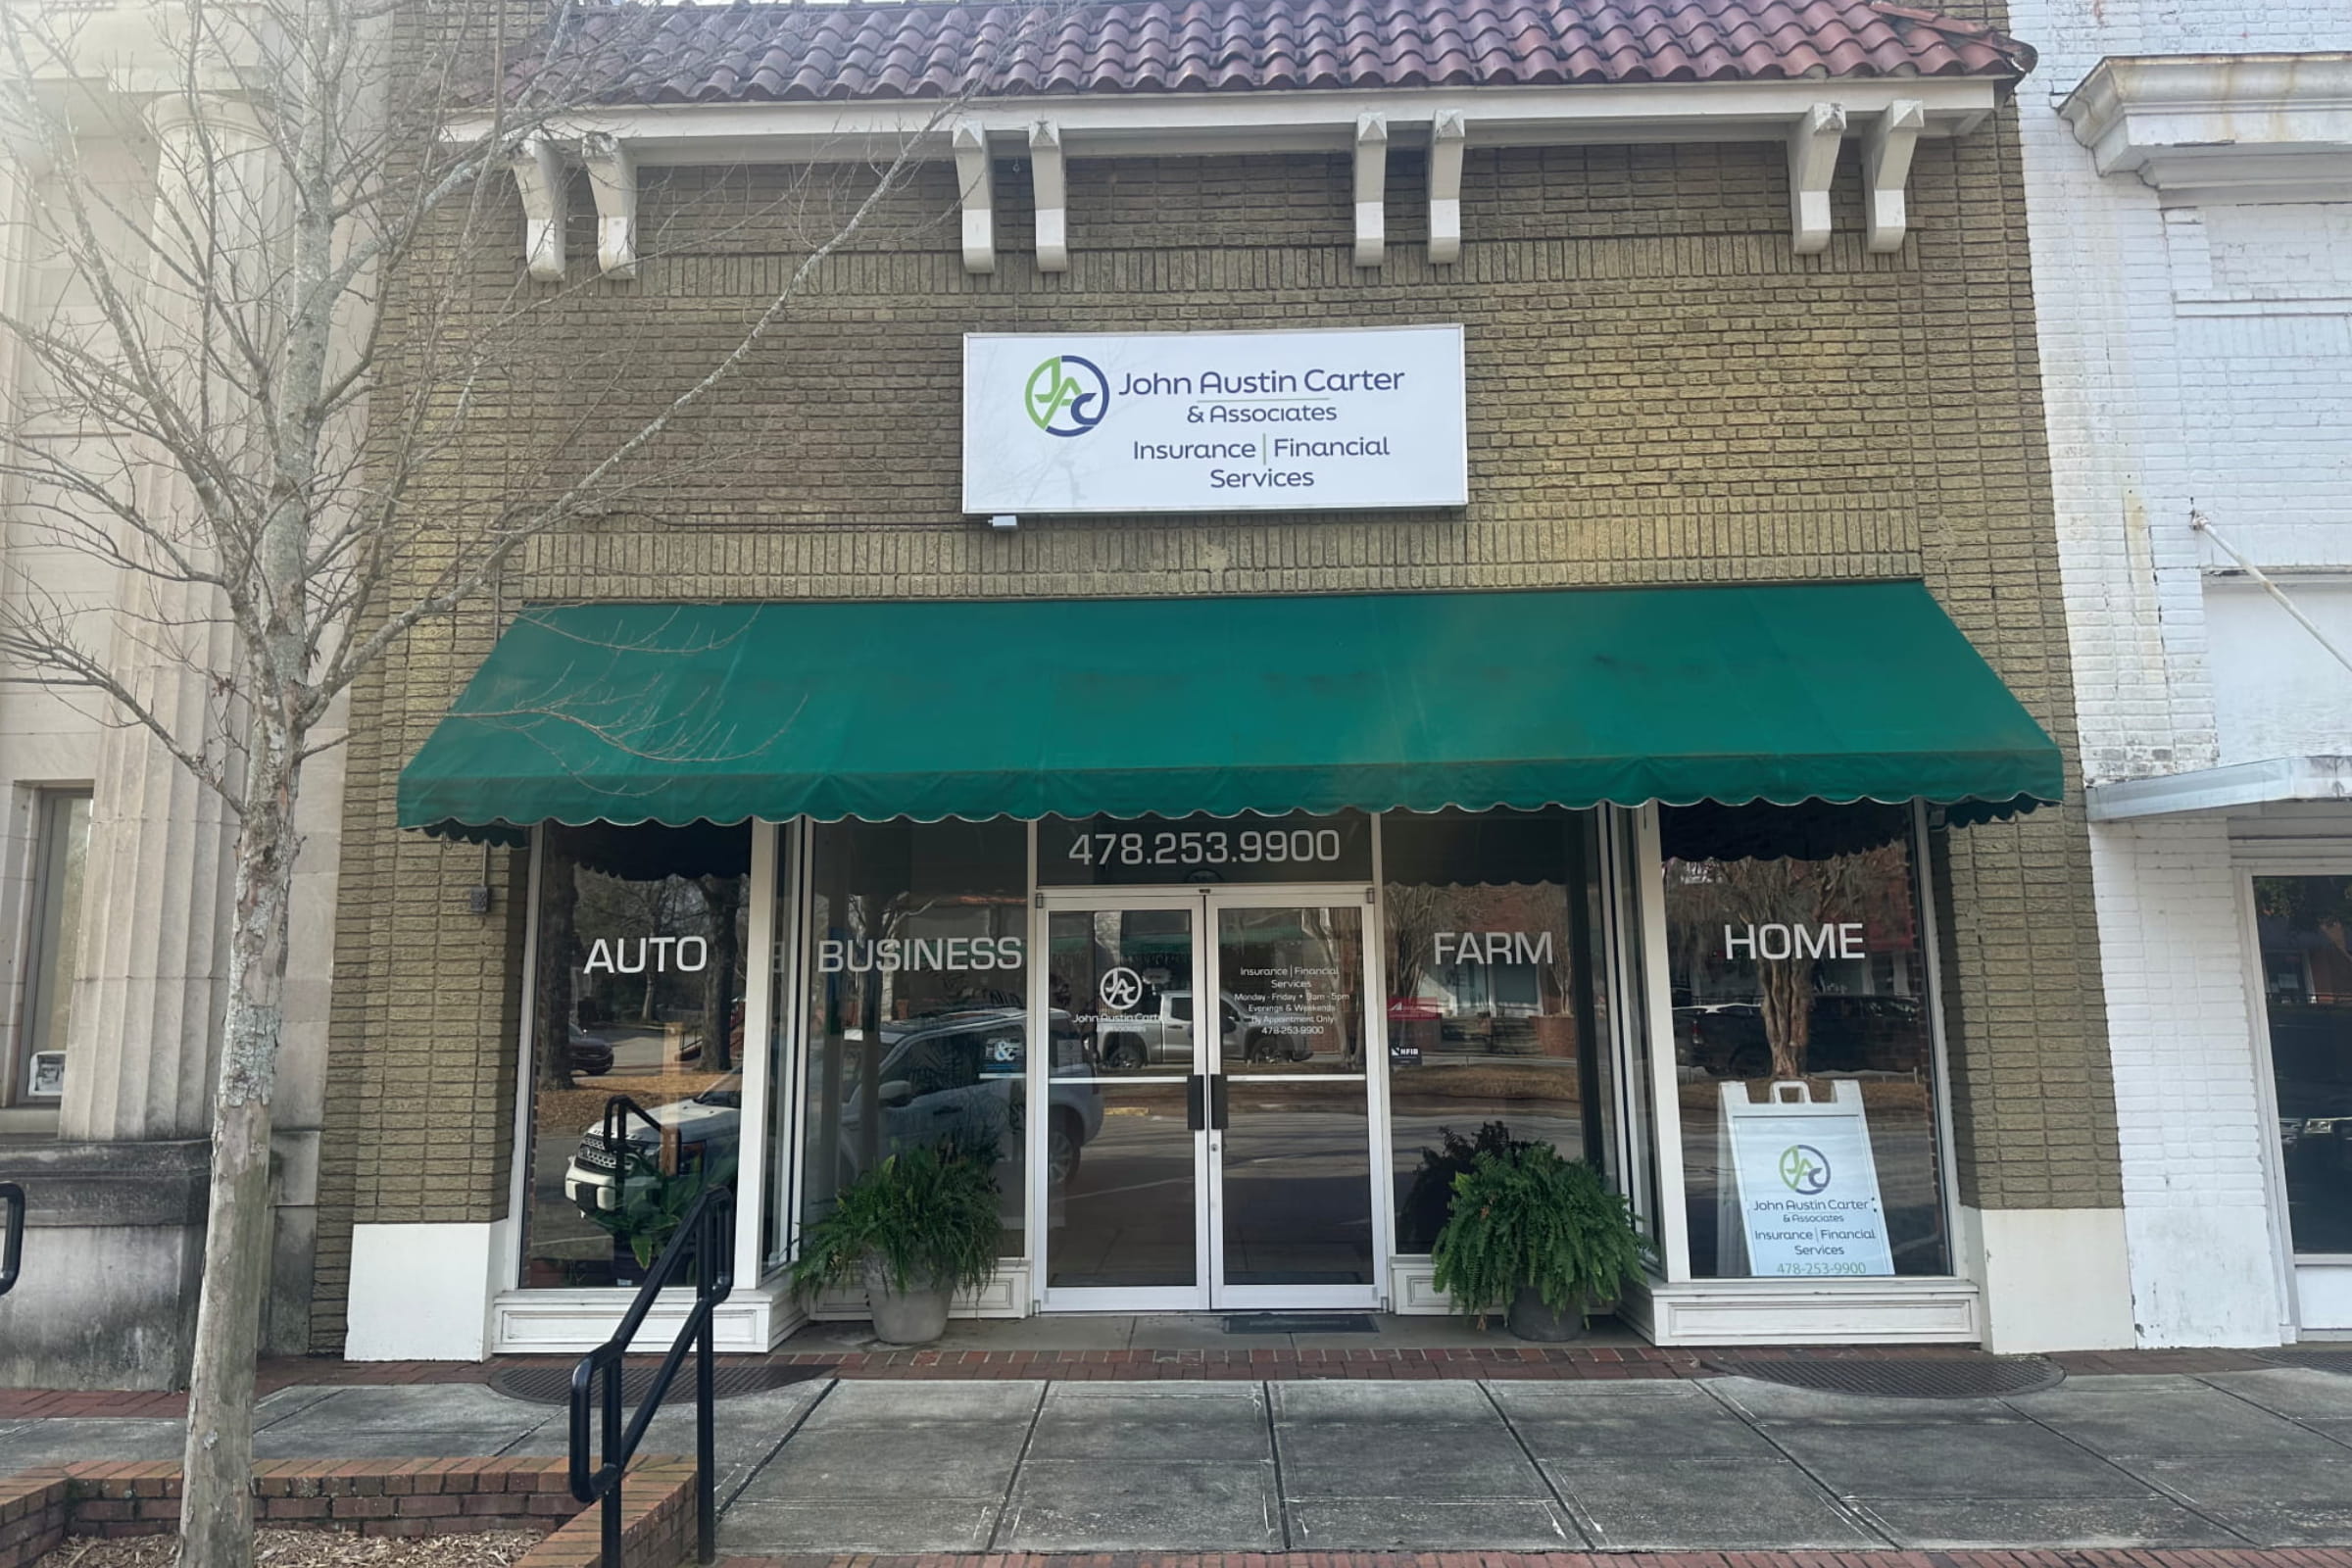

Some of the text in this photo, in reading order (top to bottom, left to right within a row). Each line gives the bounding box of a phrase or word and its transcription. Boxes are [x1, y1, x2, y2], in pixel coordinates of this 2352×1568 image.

[1118, 368, 1405, 396] John Austin Carter
[1187, 404, 1337, 422] & Associates
[1133, 437, 1390, 460] Insurance Financial
[1210, 468, 1314, 488] Services
[1068, 829, 1341, 865] 478.253.9900
[1724, 923, 1866, 960] HOME
[1434, 932, 1553, 964] FARM
[583, 936, 708, 974] AUTO
[817, 937, 1022, 973] BUSINESS
[1240, 966, 1340, 976] Insurance Financial
[1271, 980, 1312, 989] Services
[1234, 993, 1266, 1002] Monday
[1272, 993, 1297, 1002] Friday
[1249, 1004, 1284, 1013] Evenings
[1285, 1004, 1293, 1012] &
[1073, 1013, 1099, 1023] John
[1315, 1015, 1335, 1024] Only
[1261, 1025, 1325, 1035] 478-253-9900
[1753, 1199, 1869, 1211] John Austin Carter
[1792, 1213, 1844, 1222] Associates
[1755, 1228, 1876, 1240] Insurance Financial
[1794, 1245, 1845, 1255] Services
[1777, 1261, 1866, 1274] 478-253-9900
